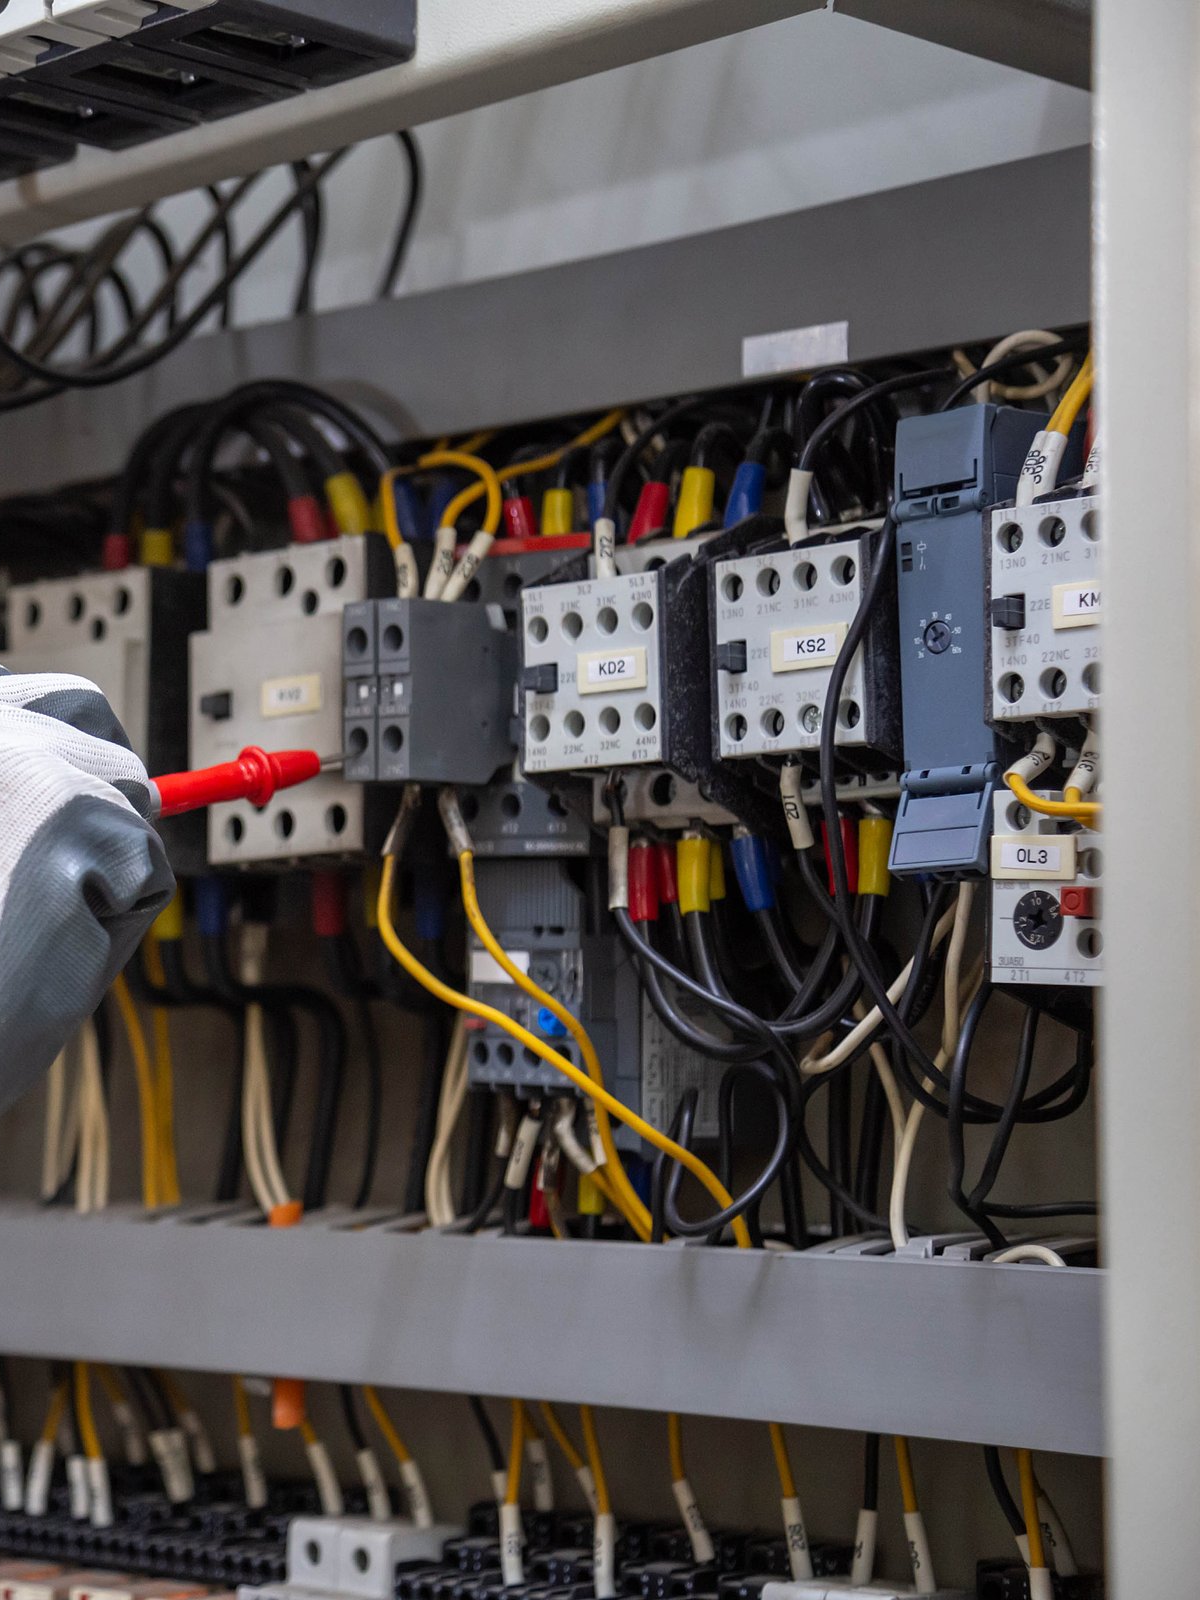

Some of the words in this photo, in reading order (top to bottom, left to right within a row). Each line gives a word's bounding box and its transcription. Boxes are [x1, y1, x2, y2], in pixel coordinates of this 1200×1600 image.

[1041, 550, 1071, 565] 21NC
[1030, 598, 1051, 612] 22E
[1079, 591, 1101, 608] KM
[796, 638, 826, 655] KS2
[1041, 648, 1071, 663] 22NC
[598, 660, 626, 676] KD2
[1031, 897, 1042, 906] 10
[1019, 916, 1027, 928] 12
